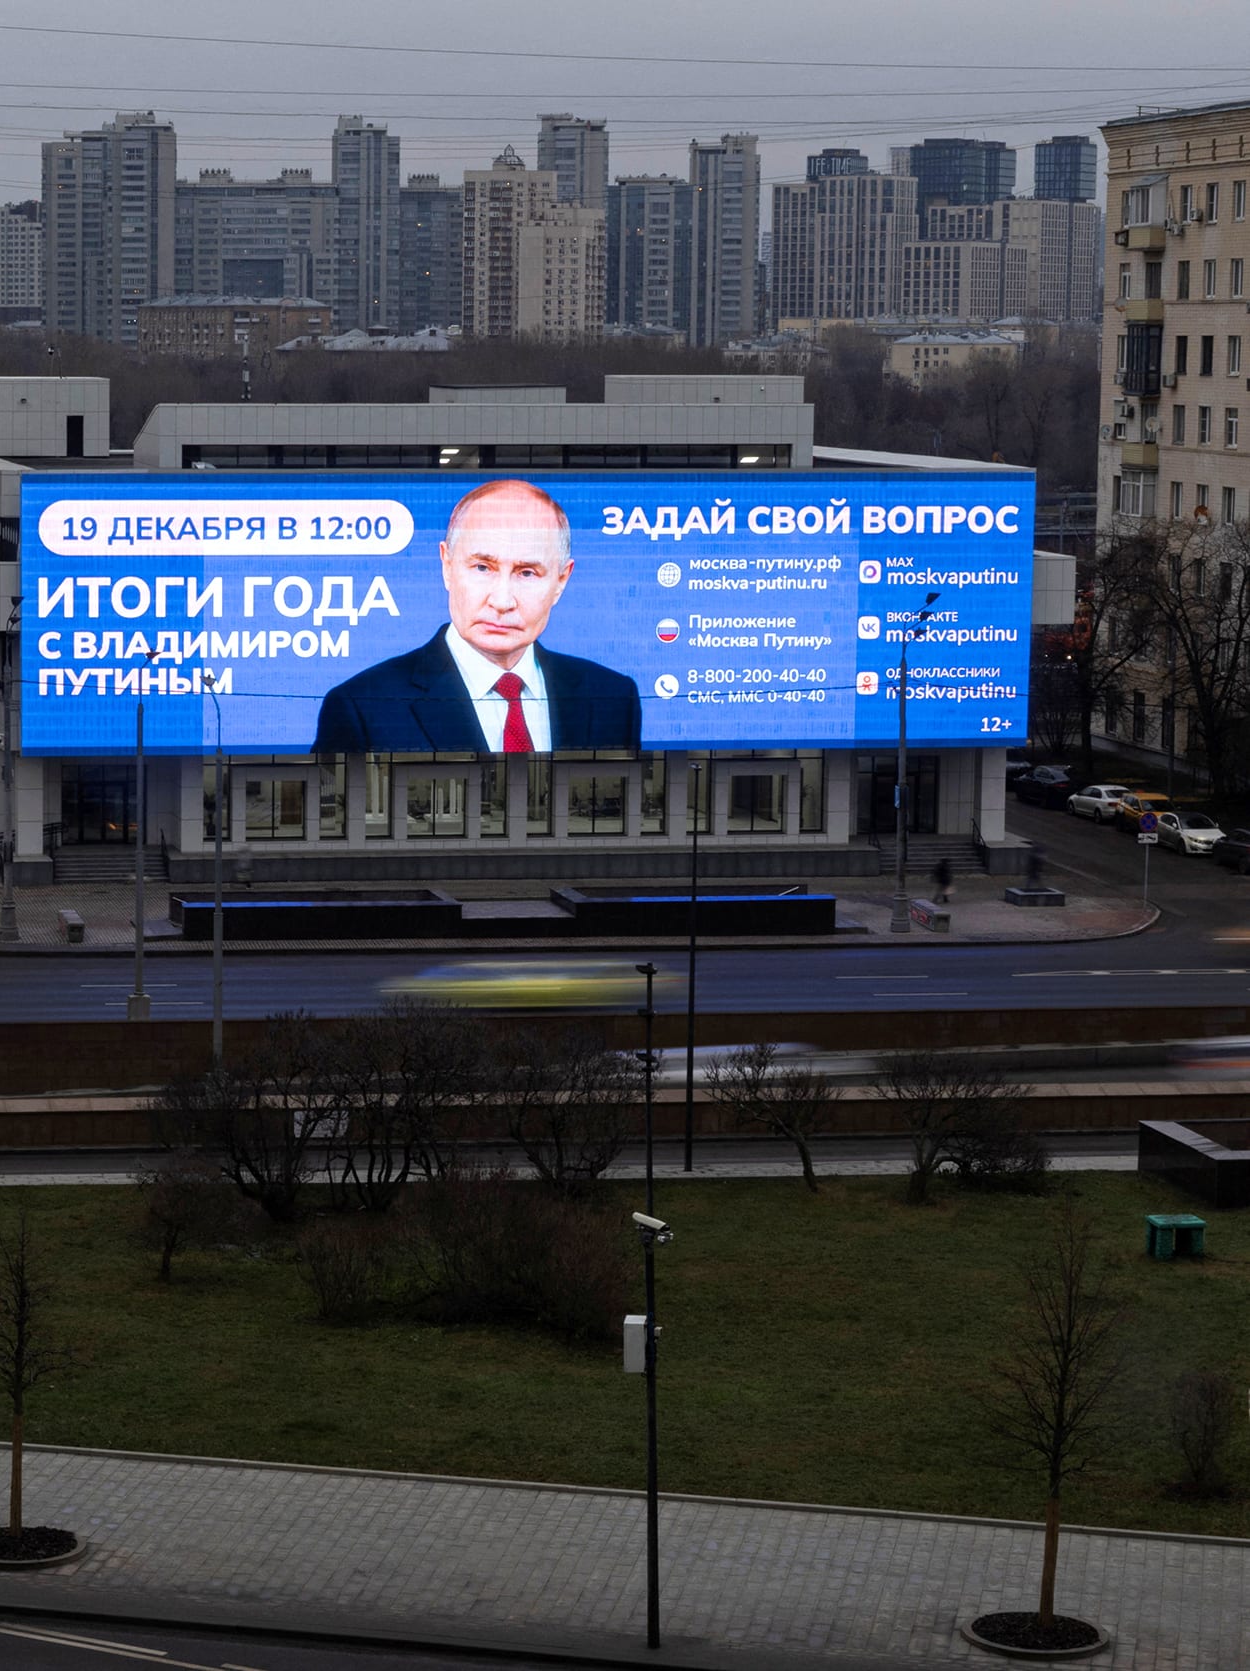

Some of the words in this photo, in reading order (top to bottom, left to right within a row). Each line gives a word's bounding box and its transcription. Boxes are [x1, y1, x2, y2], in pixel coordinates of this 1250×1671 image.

[601, 498, 736, 541] ЗАДАЙ
[747, 498, 851, 535] СВОЙ
[862, 505, 1020, 535] ВОПРОС
[62, 516, 98, 541] 19
[107, 516, 266, 544] ДЕКАБРЯ
[278, 516, 298, 540] В
[310, 516, 392, 540] 12:00
[689, 554, 842, 573] москва-путину.рф
[886, 557, 915, 568] MAX
[688, 575, 827, 594] moskva-putinu.ru
[886, 567, 1019, 589] moskvaputinu
[37, 576, 224, 619] ИТОГИ
[242, 575, 402, 627] ГОДА
[689, 614, 797, 632] Приложение
[886, 611, 959, 623] ВКОНАКТЕ
[688, 633, 759, 648] «Москва
[763, 632, 832, 651] Путину»
[885, 624, 1018, 646] moskvaputinu
[37, 631, 62, 660] С
[72, 630, 351, 665] ВЛАДИМИРОМ
[38, 667, 234, 696] ПУТИНЫМ
[687, 668, 827, 684] 8-800-200-40-40
[687, 690, 725, 704] СМС,
[728, 690, 764, 703] ММС
[767, 689, 826, 703] 0-40-40
[980, 716, 1013, 732] 12+
